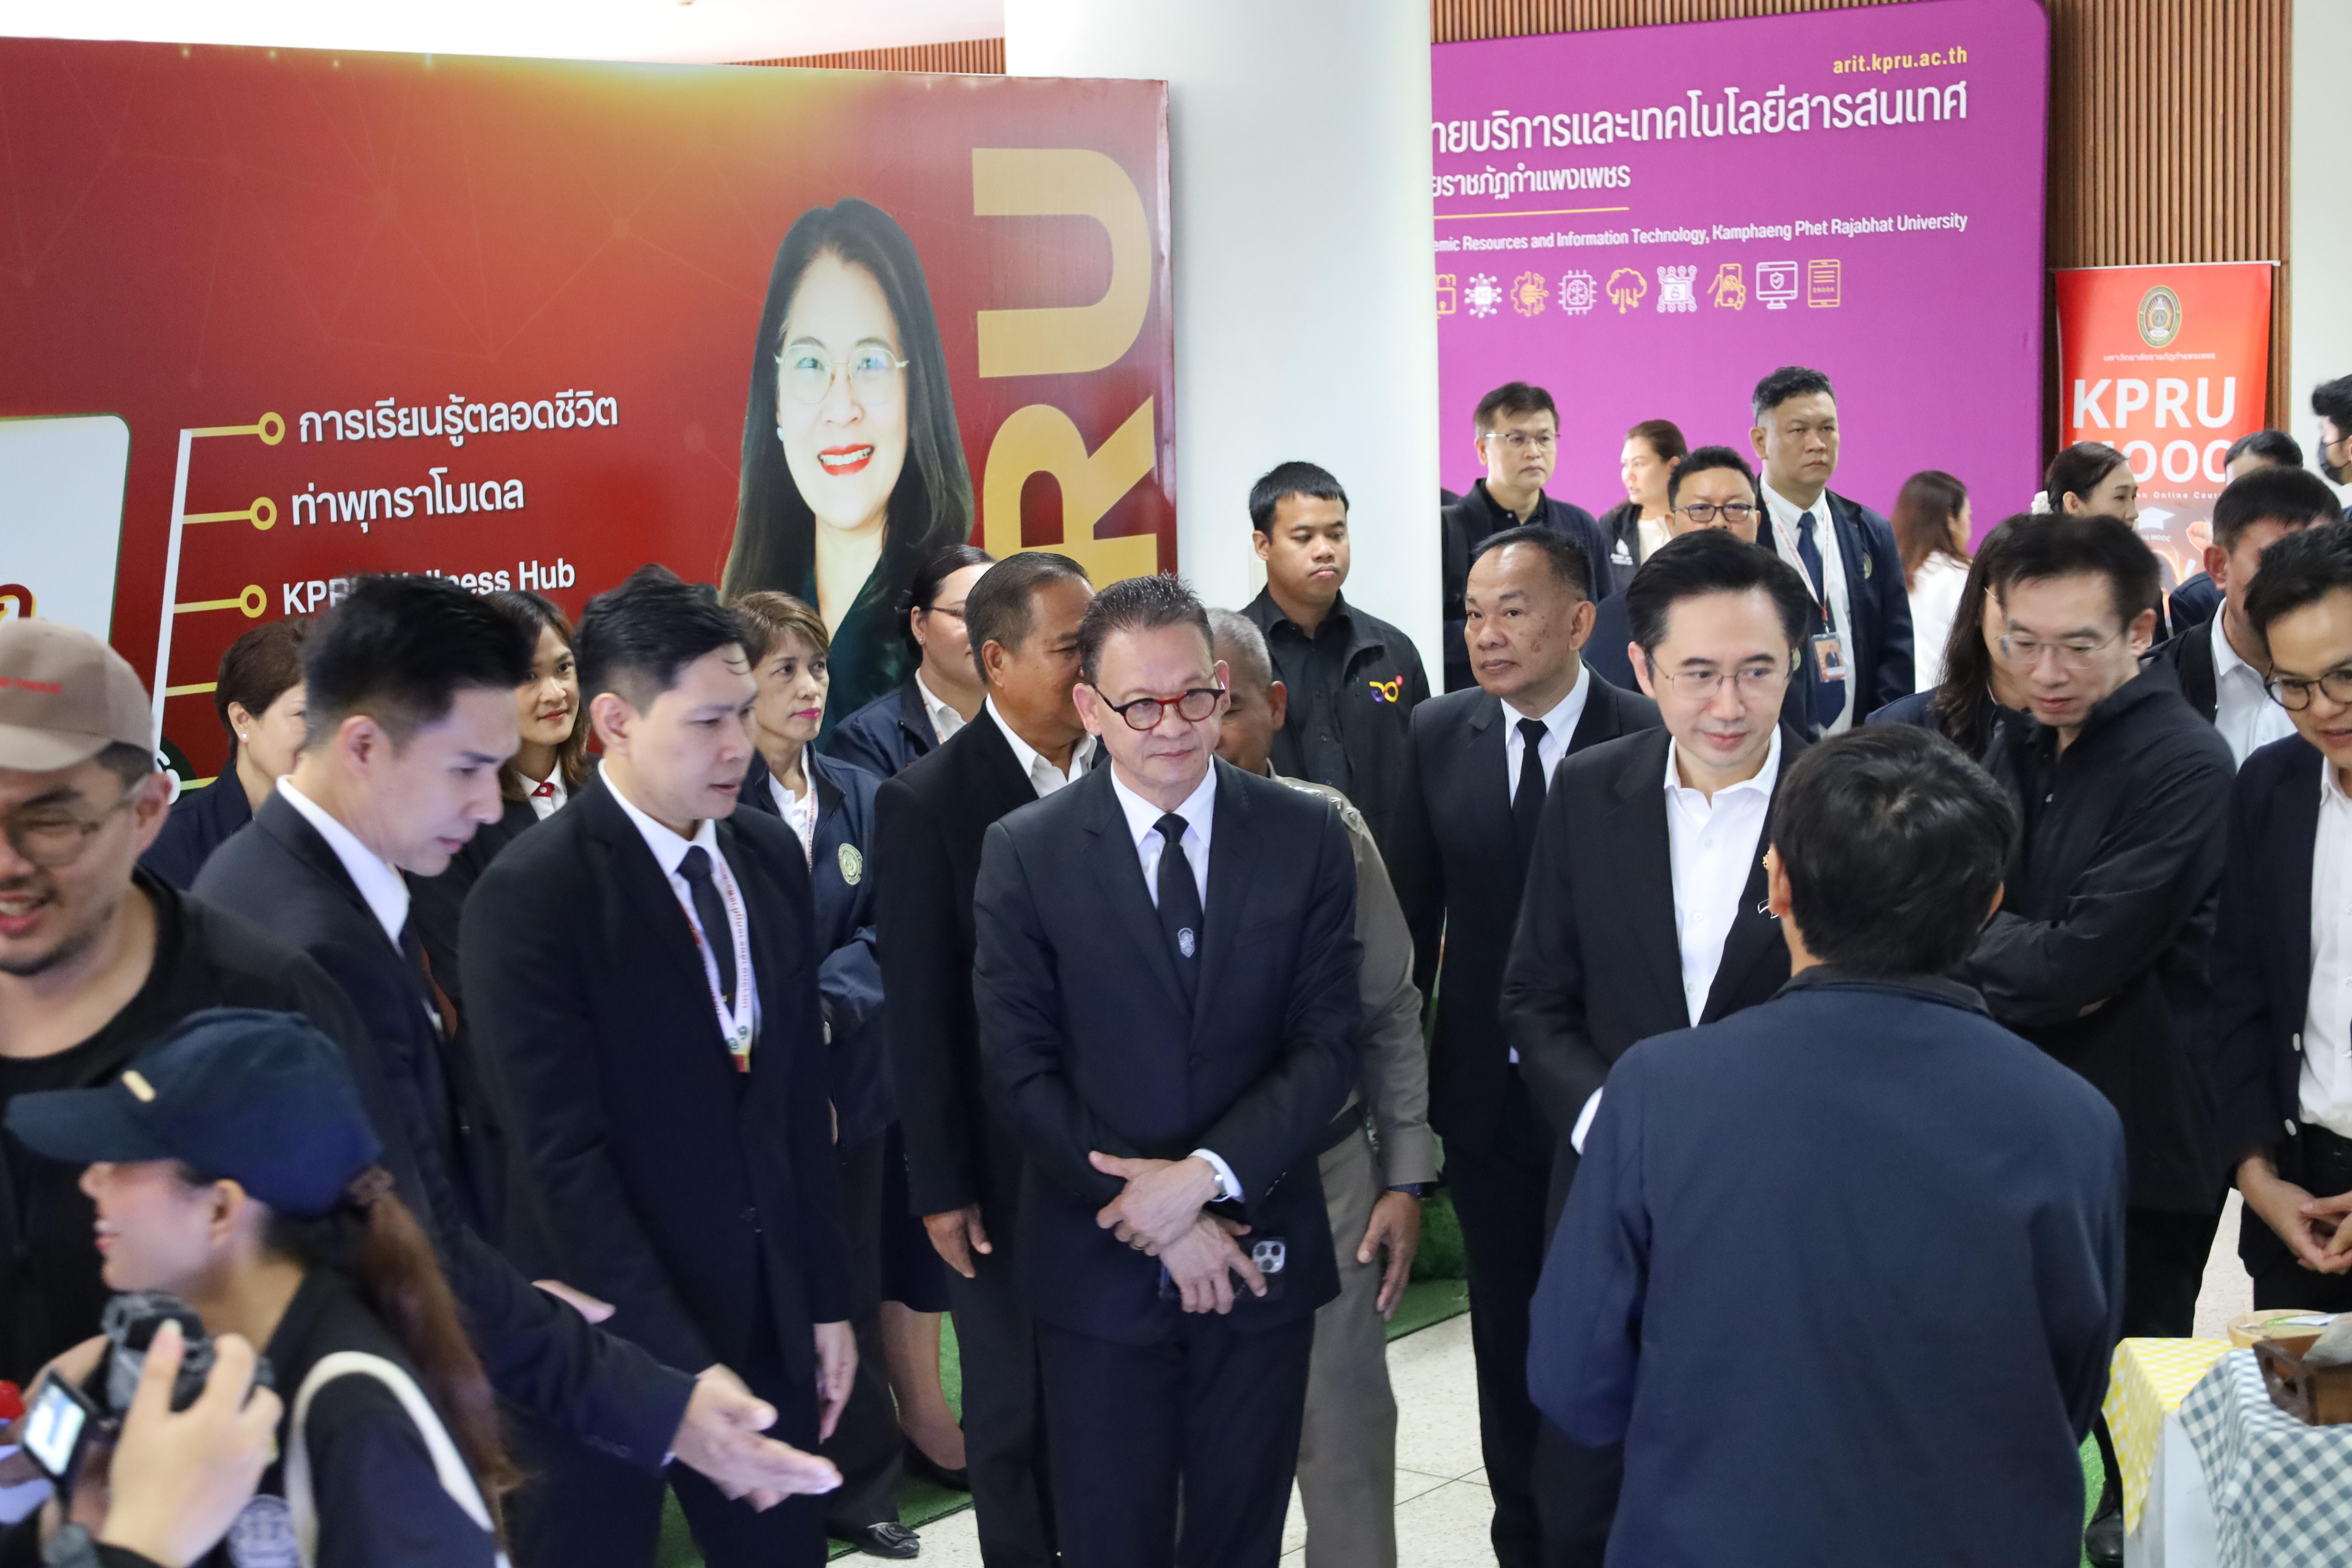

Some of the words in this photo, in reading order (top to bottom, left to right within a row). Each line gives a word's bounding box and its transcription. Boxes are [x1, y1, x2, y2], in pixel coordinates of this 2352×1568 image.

[1833, 46, 1968, 74] arit.kpru.ac.th
[1462, 236, 1529, 251] Resources
[1531, 232, 1555, 248] and
[1557, 230, 1629, 247] Information
[1631, 226, 1710, 245] Technology,
[1712, 223, 1792, 243] Kamphaeng
[1795, 220, 1829, 236] Phet
[1831, 217, 1895, 238] Rajabhat
[1897, 212, 1968, 232] University
[299, 389, 619, 447] การเรียนรู้ตลอดชีวิต
[2073, 377, 2236, 429] KPRU
[2073, 439, 2232, 483] OOC
[292, 467, 524, 533] ท่าพุทราโมเดล
[283, 578, 358, 615] KPR
[519, 558, 576, 590] Hub
